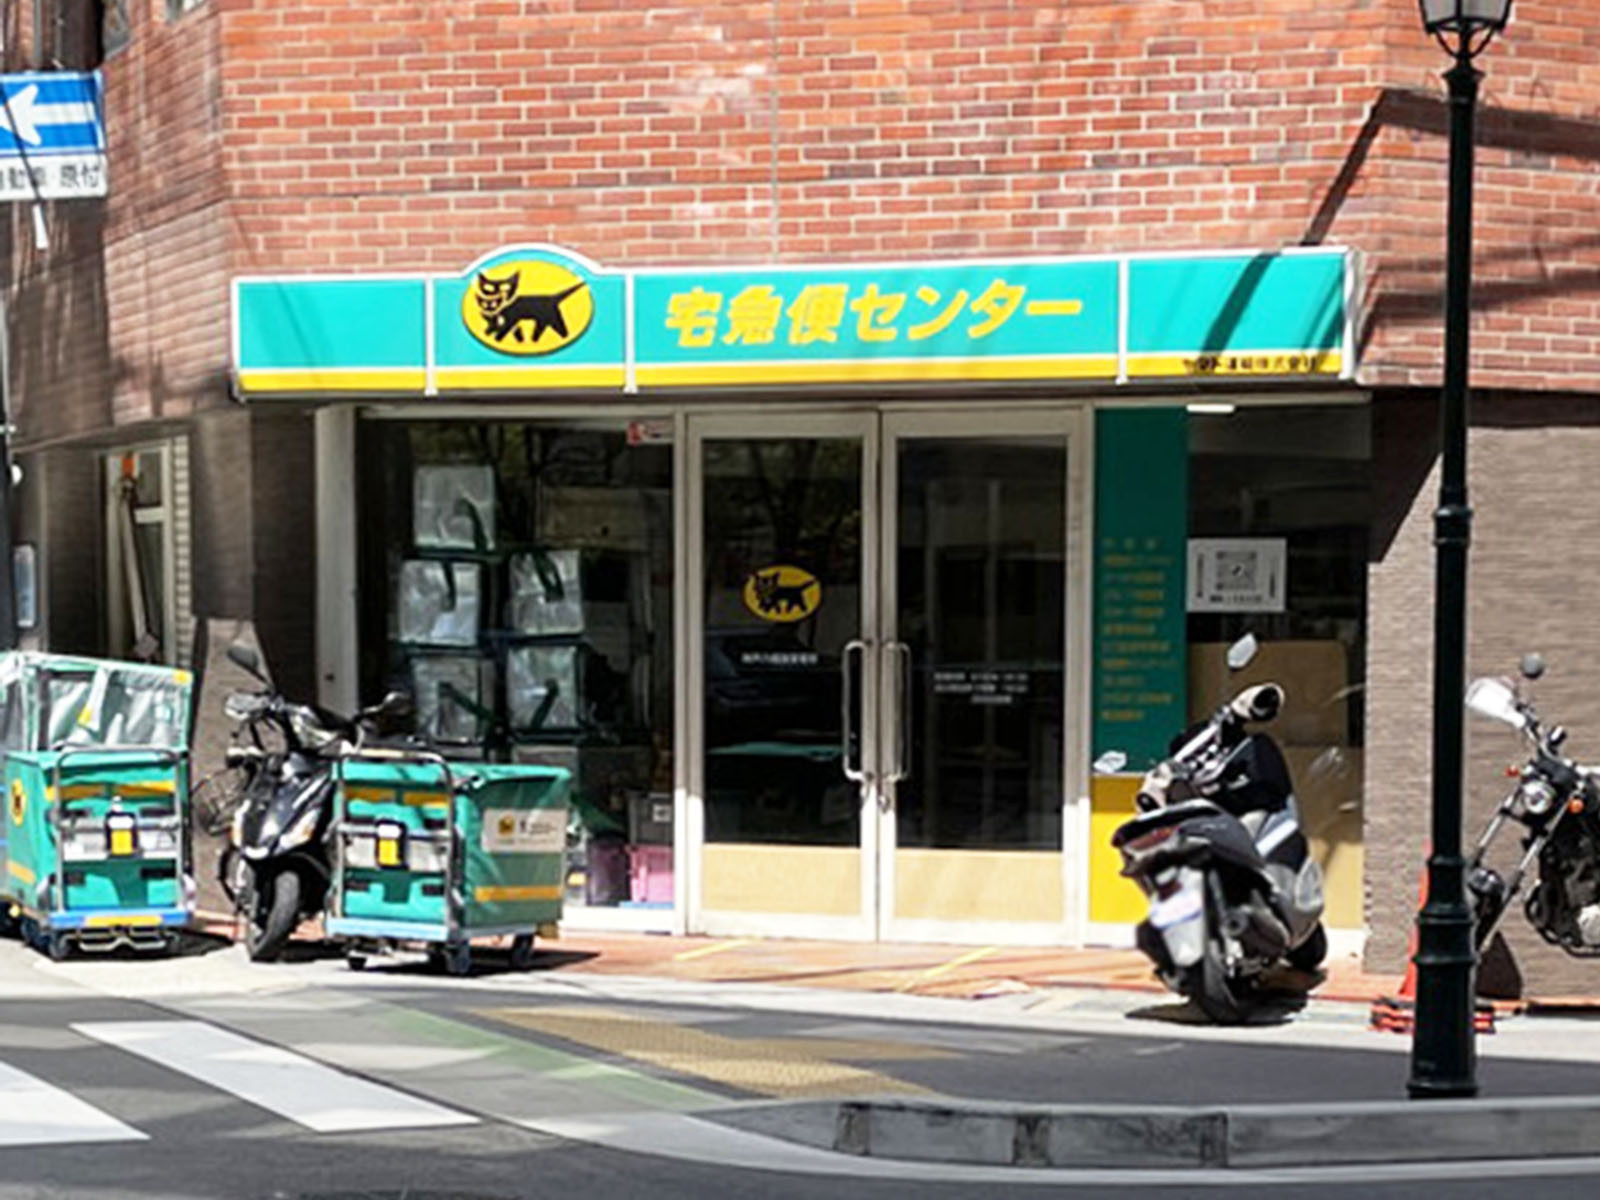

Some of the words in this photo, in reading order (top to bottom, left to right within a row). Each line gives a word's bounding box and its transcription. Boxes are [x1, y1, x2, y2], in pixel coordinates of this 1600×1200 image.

[665, 278, 1083, 348] 宅急便センター
